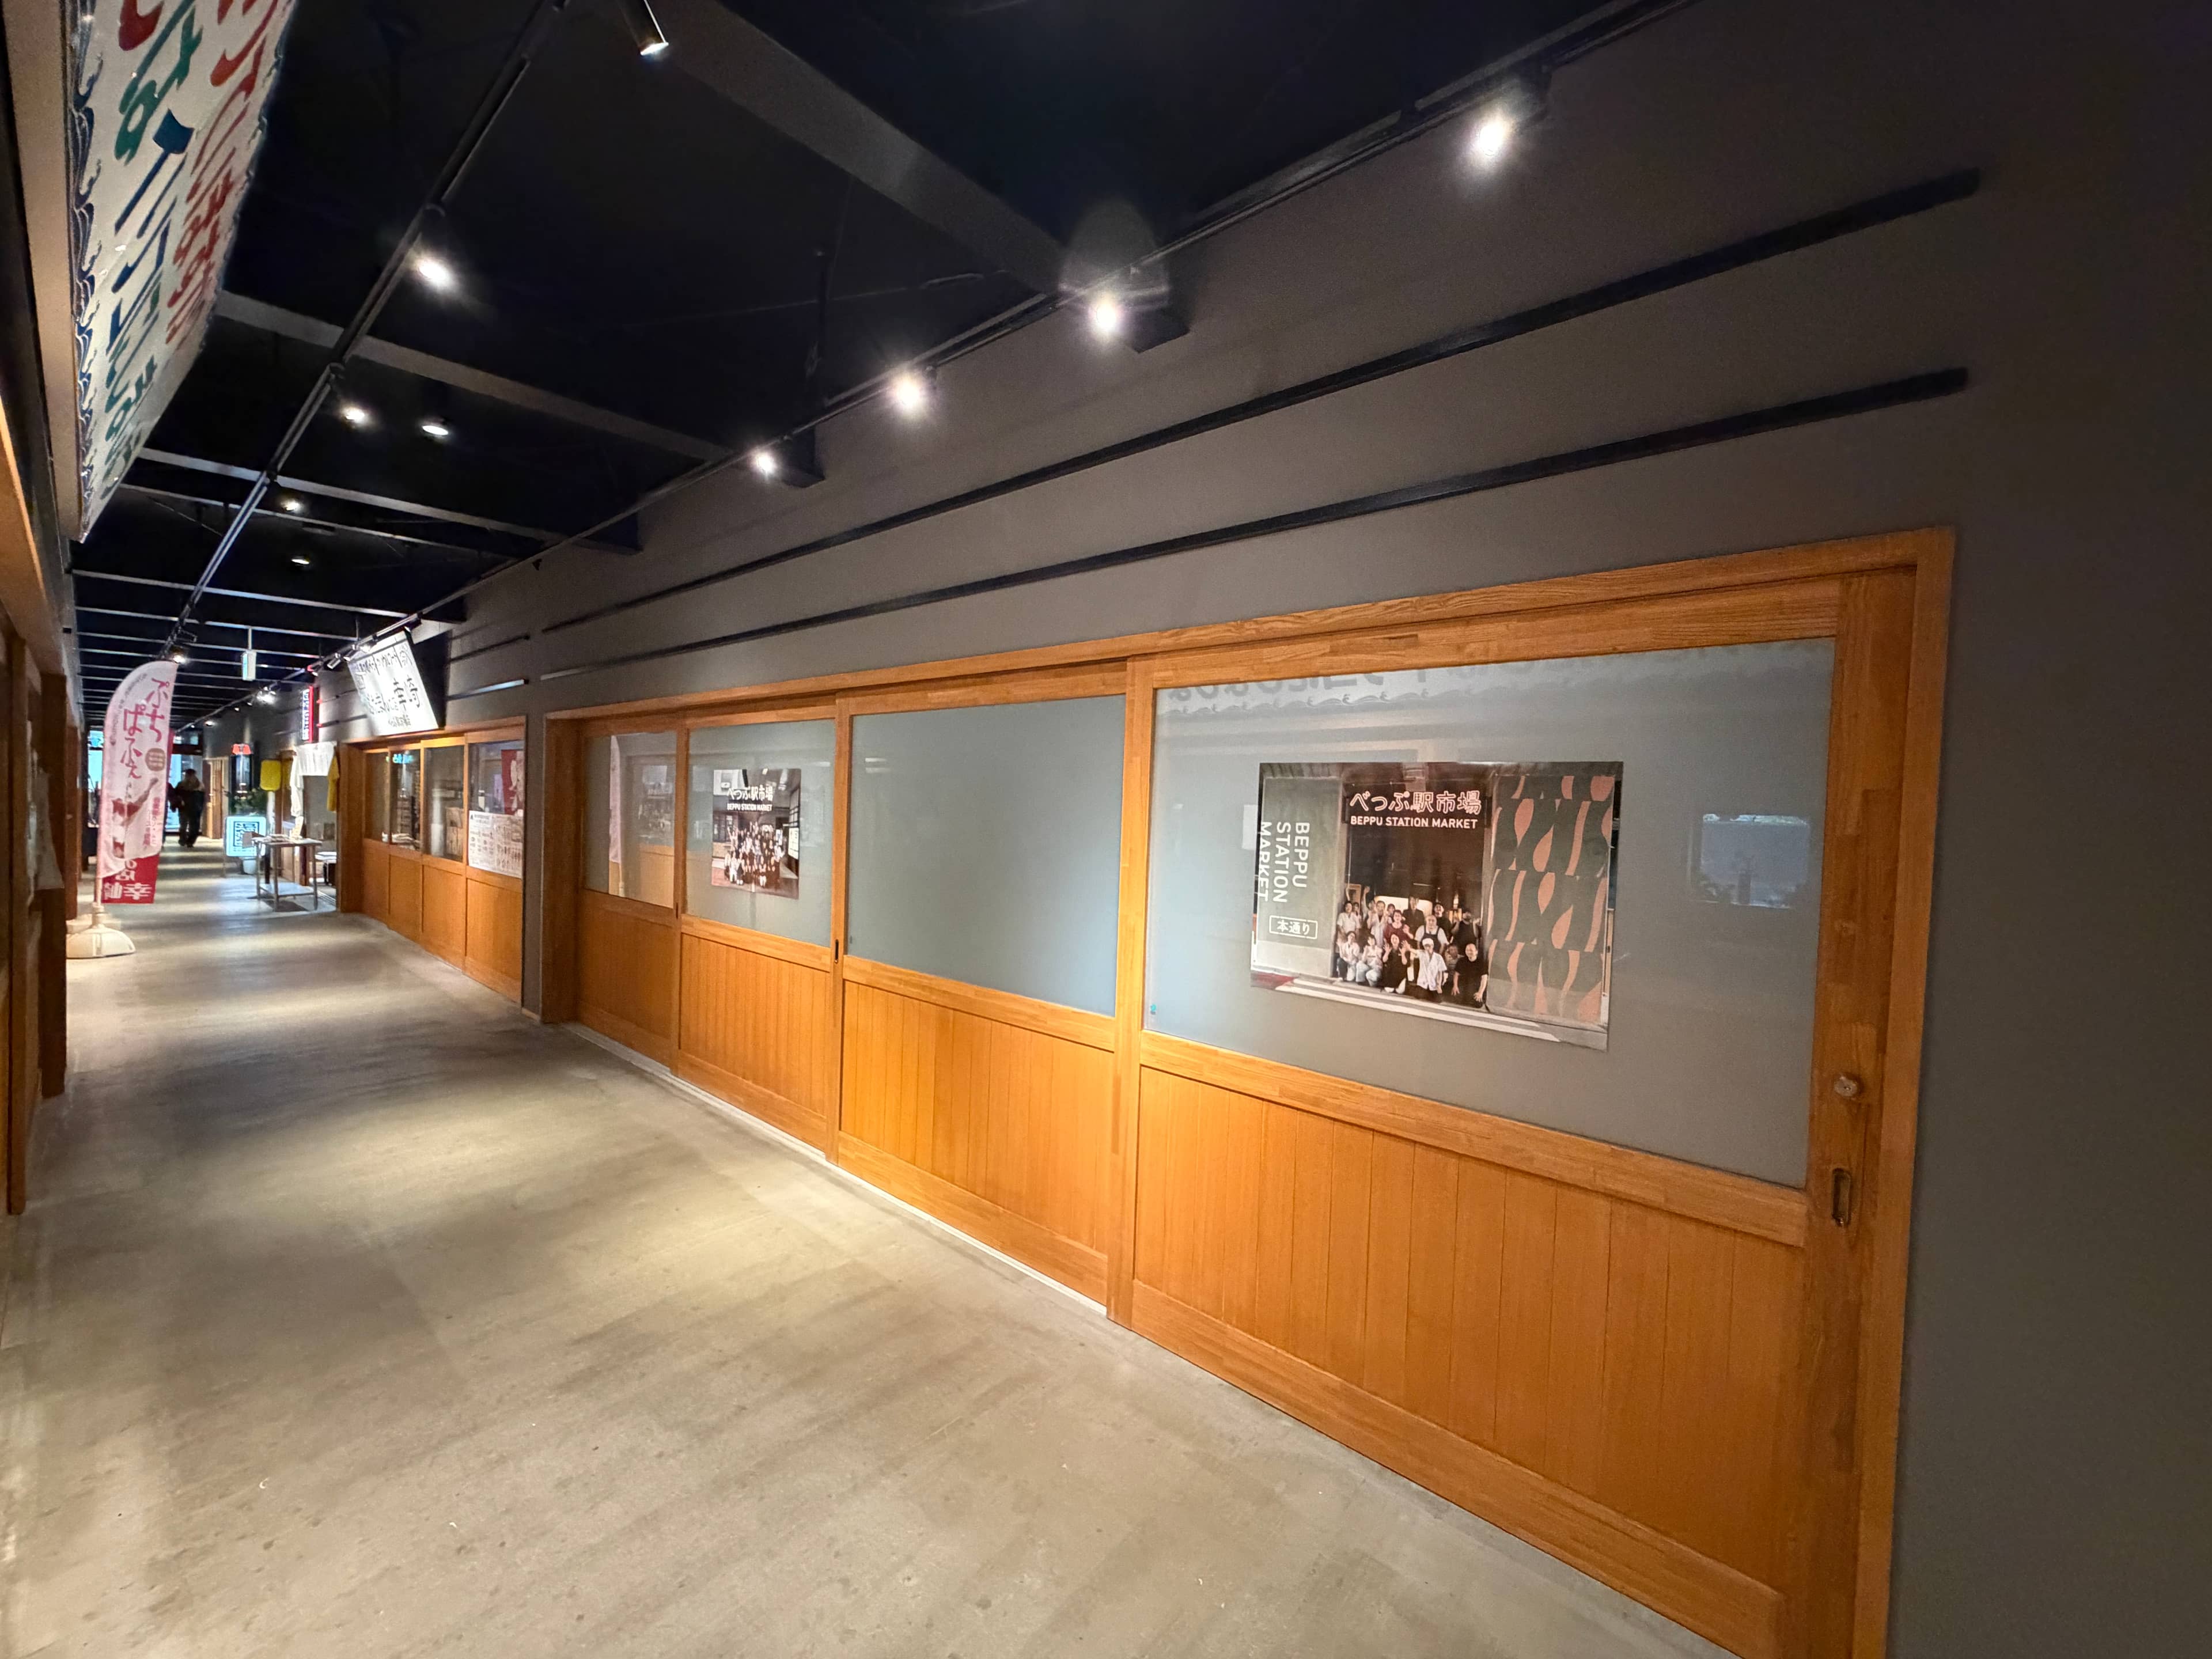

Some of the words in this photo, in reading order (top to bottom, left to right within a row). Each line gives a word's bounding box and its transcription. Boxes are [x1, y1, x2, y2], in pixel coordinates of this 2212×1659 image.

[120, 704, 146, 779] ぱふぇ
[146, 677, 169, 743] ぷち
[1350, 790, 1481, 815] べっぷ駅市場
[1350, 816, 1382, 825] BEPPU
[1385, 817, 1429, 827] STATION
[1432, 818, 1478, 829] MARKET
[1257, 821, 1272, 902] MARKET
[1272, 821, 1291, 902] STATION
[1292, 822, 1310, 888] BEPPU
[1277, 920, 1310, 935] 本通り
